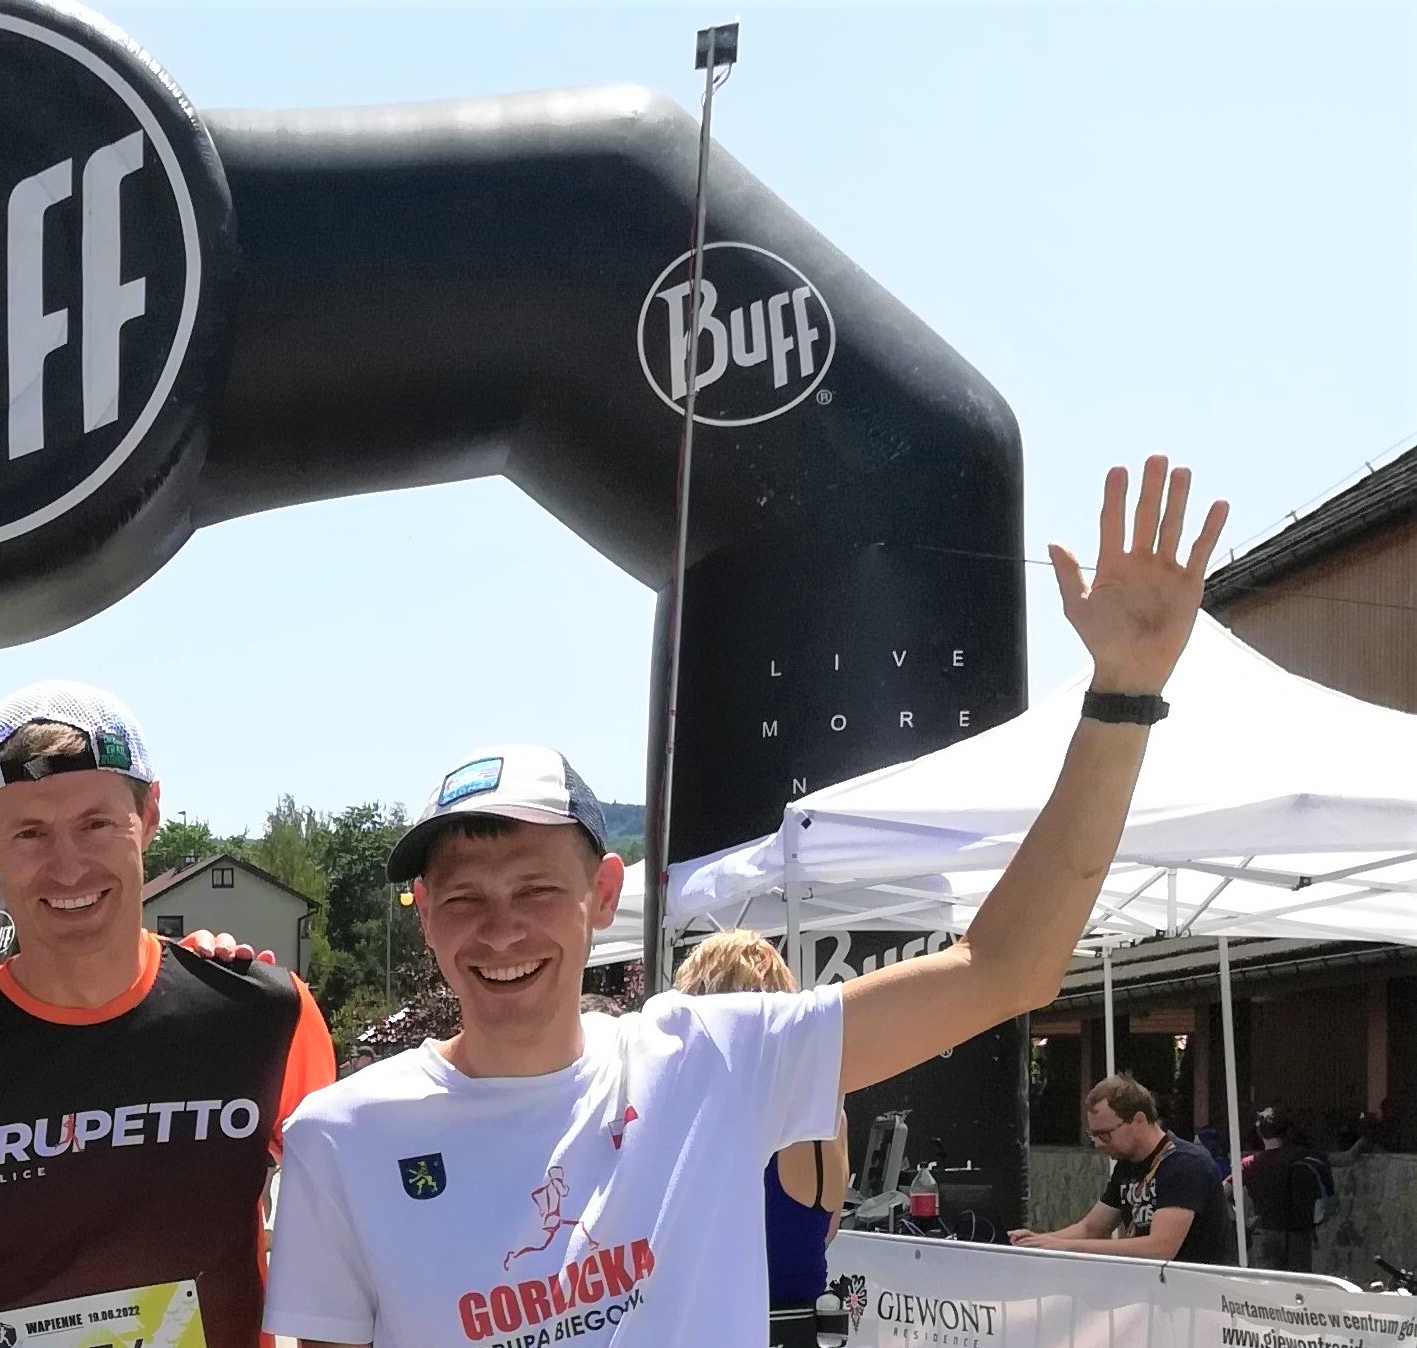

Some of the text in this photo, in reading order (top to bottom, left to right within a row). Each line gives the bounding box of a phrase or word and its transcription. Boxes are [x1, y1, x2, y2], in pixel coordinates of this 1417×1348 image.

[770, 650, 965, 677] LIVE
[761, 710, 971, 739] MORE
[26, 1313, 84, 1334] WAPIENNE
[877, 1291, 997, 1336] GIEWONT
[1221, 1294, 1328, 1328] Apartamentowiec
[1328, 1313, 1341, 1328] w
[1342, 1313, 1399, 1335] centrum
[893, 1326, 979, 1348] RESIDENCE
